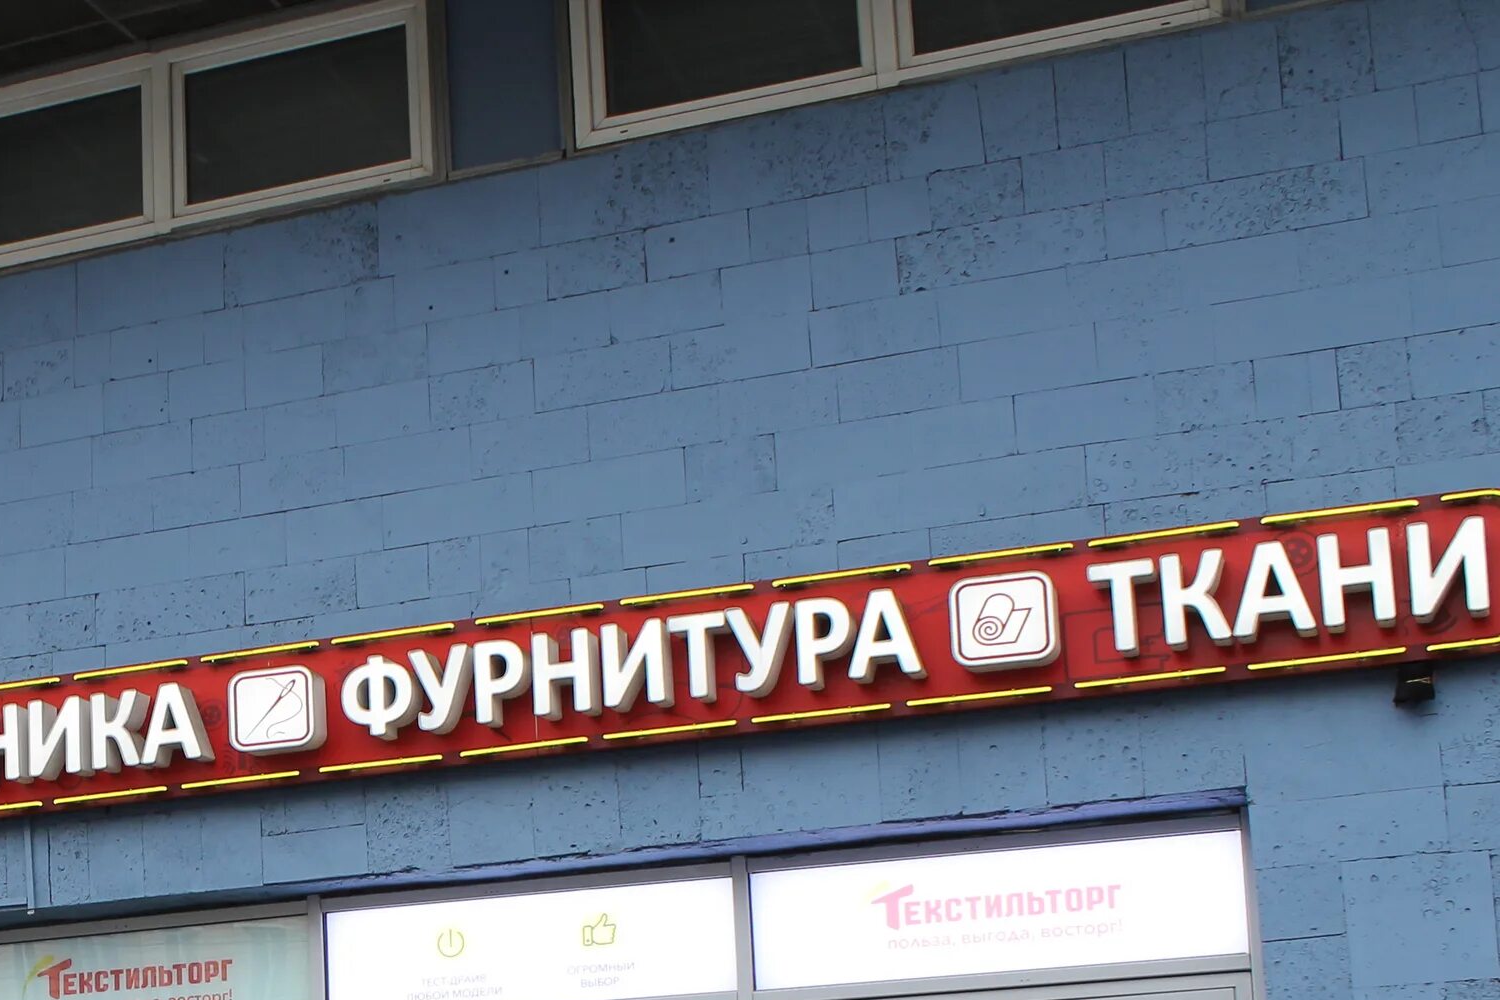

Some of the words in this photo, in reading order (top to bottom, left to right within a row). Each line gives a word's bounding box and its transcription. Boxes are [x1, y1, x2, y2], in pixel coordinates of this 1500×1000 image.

[340, 588, 924, 738] ФУРНИТУРА
[1086, 515, 1490, 656] ТКАНИ
[580, 975, 620, 988] ВЫБОР
